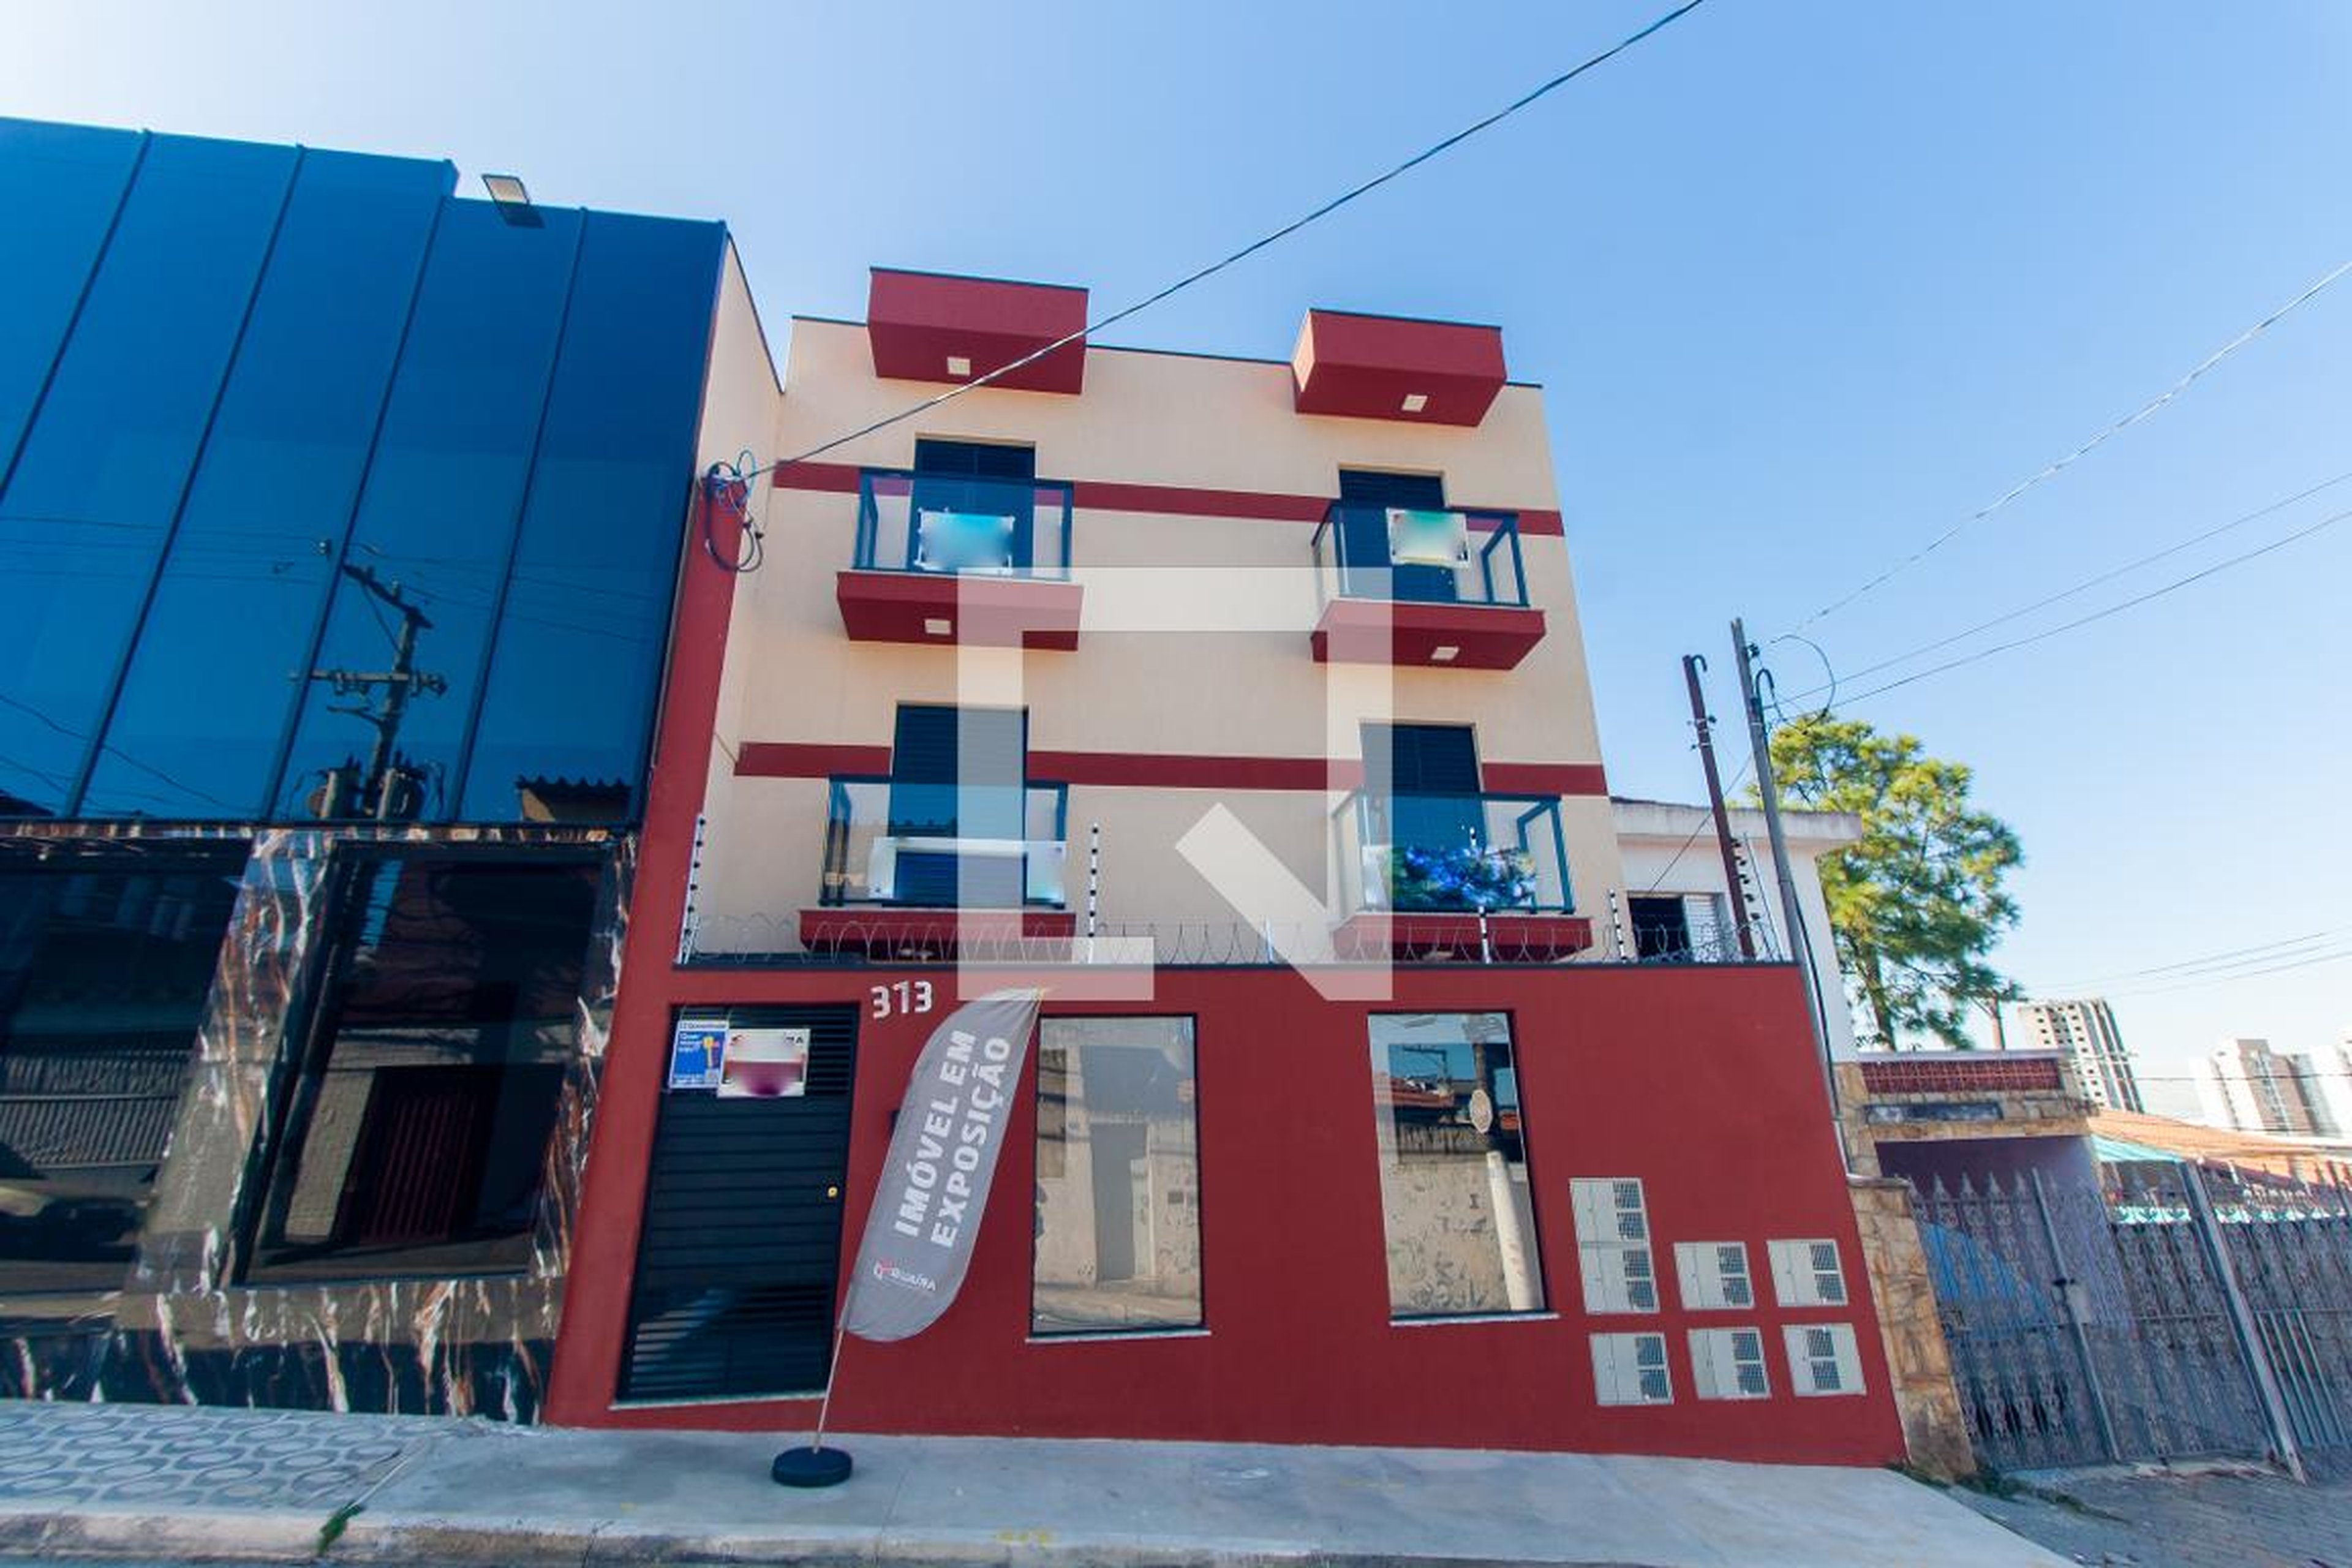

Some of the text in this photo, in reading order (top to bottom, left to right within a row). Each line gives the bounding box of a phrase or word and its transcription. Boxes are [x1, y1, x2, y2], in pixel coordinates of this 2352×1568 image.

[870, 981, 932, 1019] 313
[894, 1030, 976, 1237] IMÓVEL EM
[930, 1038, 1010, 1247] EXPOSIÇÃO
